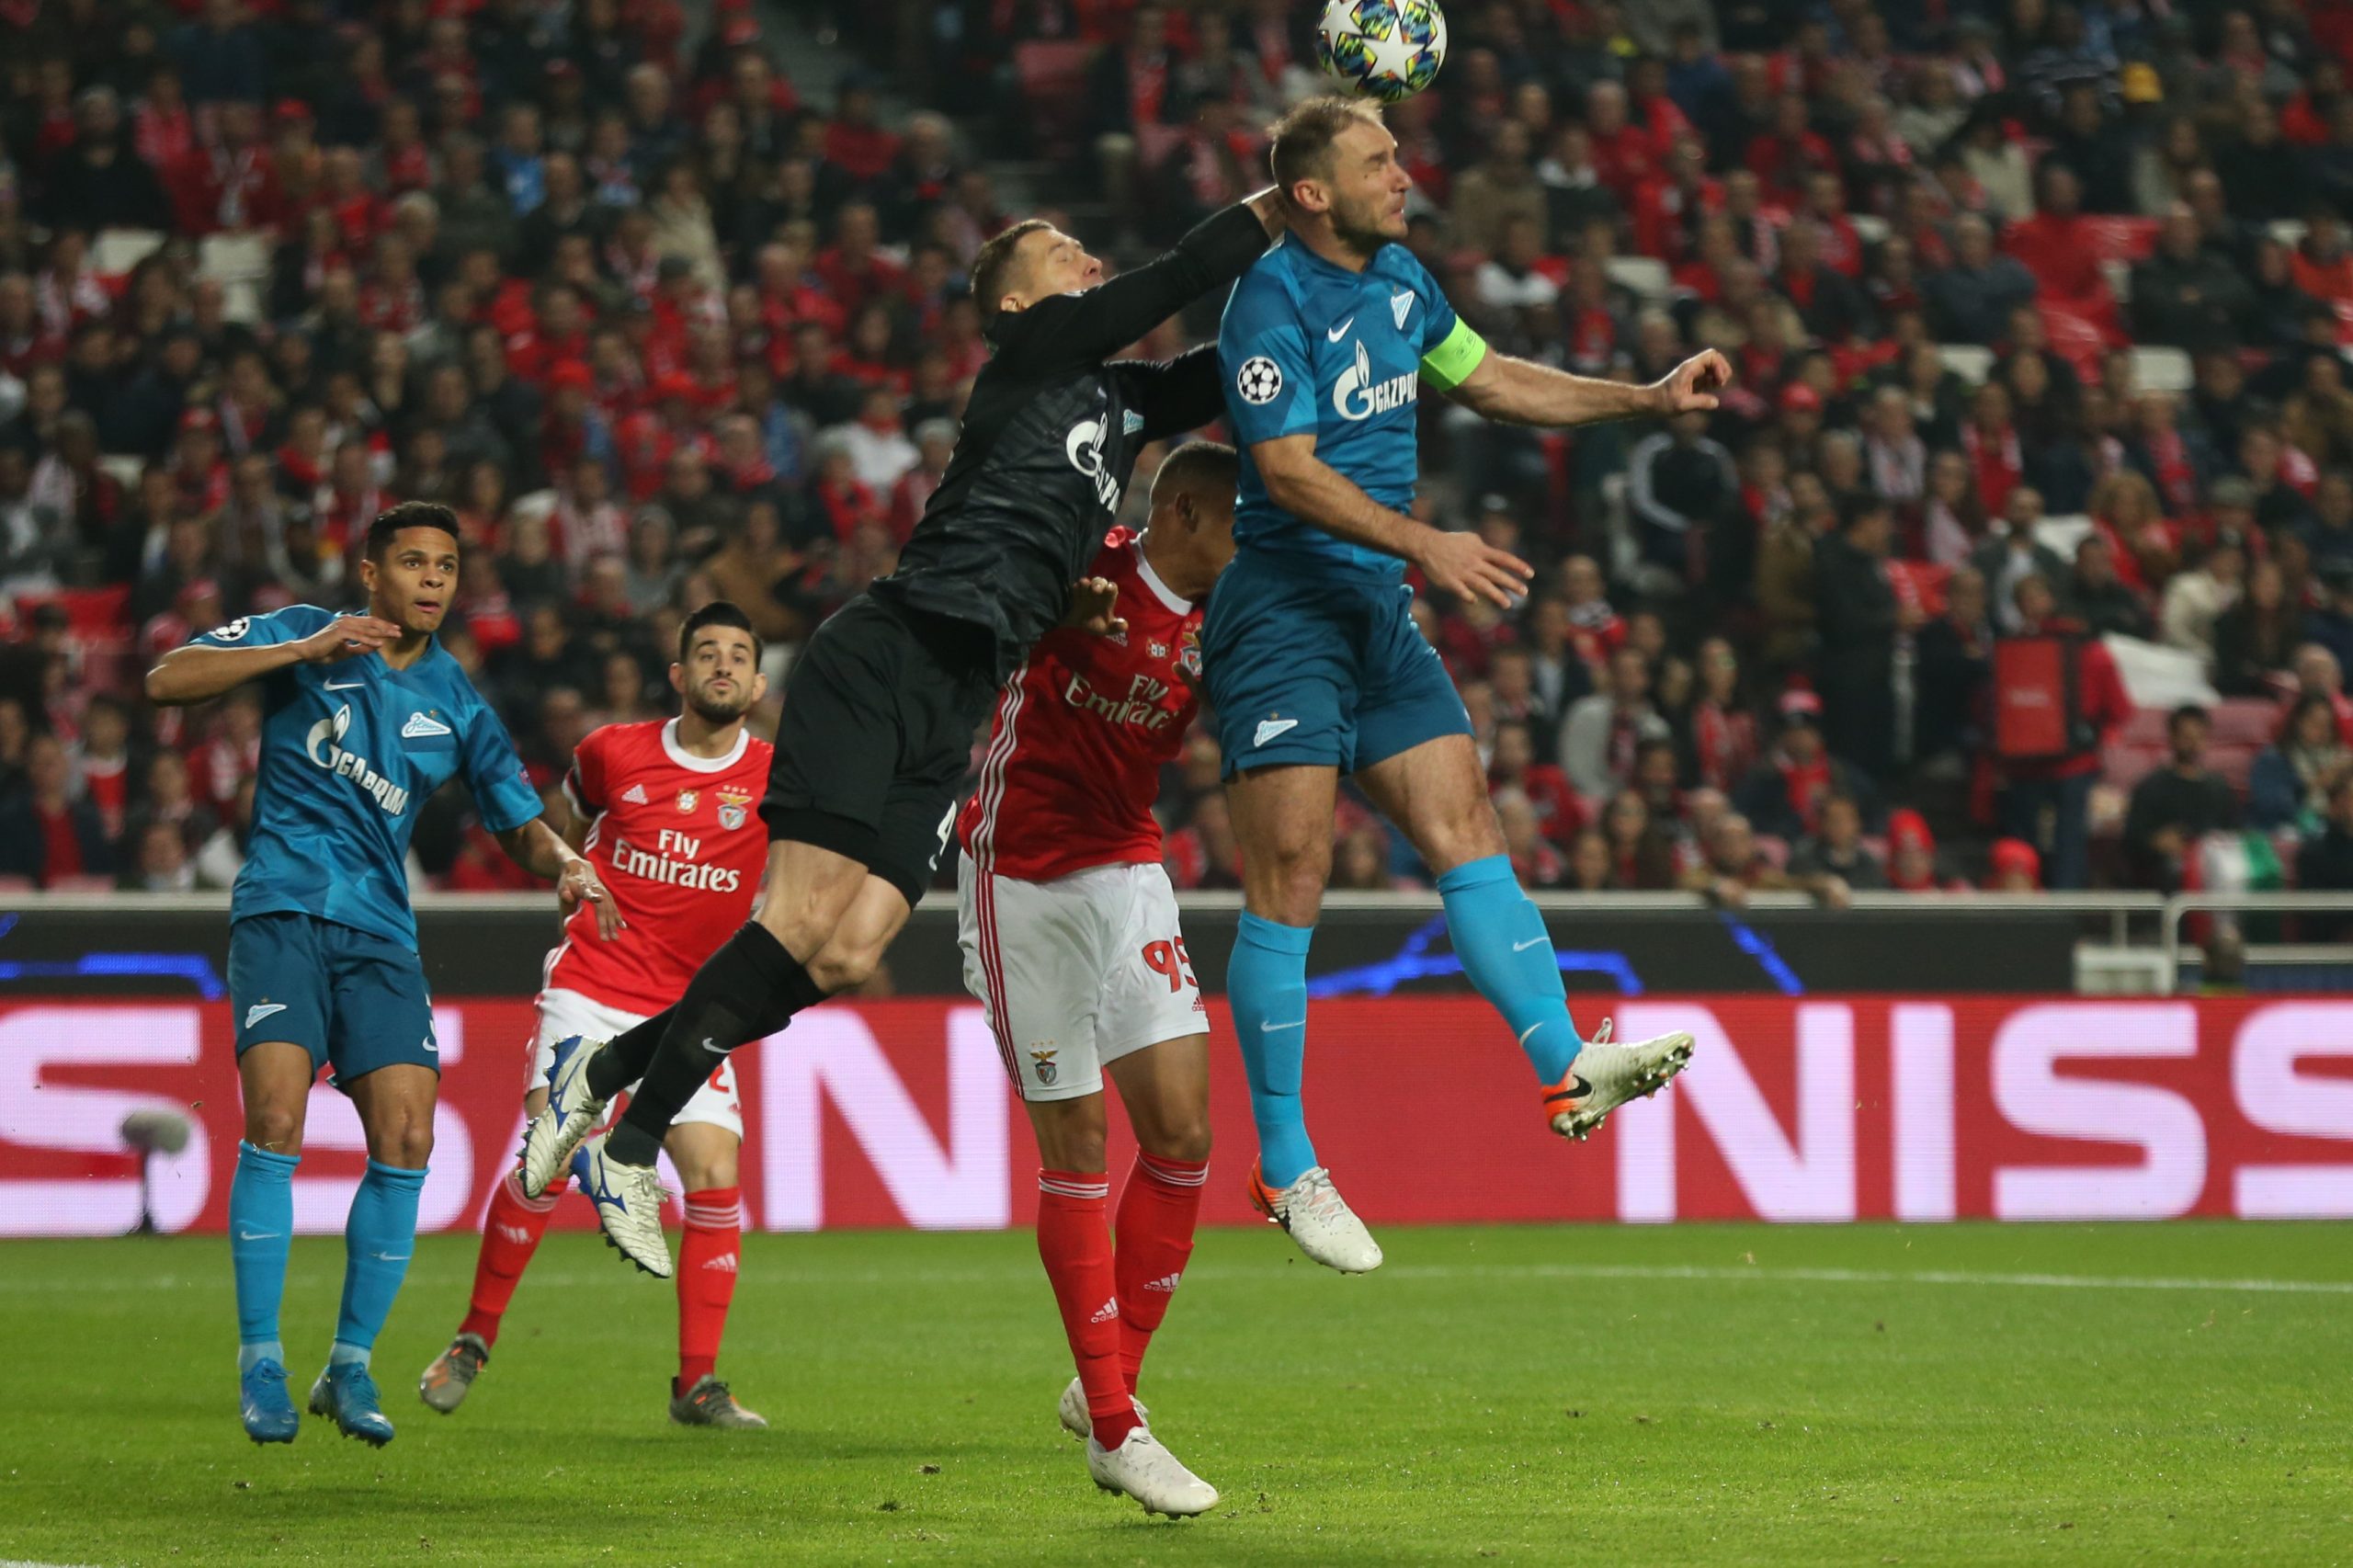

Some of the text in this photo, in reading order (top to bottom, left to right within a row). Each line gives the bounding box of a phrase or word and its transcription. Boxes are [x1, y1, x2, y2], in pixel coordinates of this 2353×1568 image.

[1128, 673, 1169, 701] Fly
[658, 828, 700, 859] Fly
[611, 837, 741, 892] Emirates
